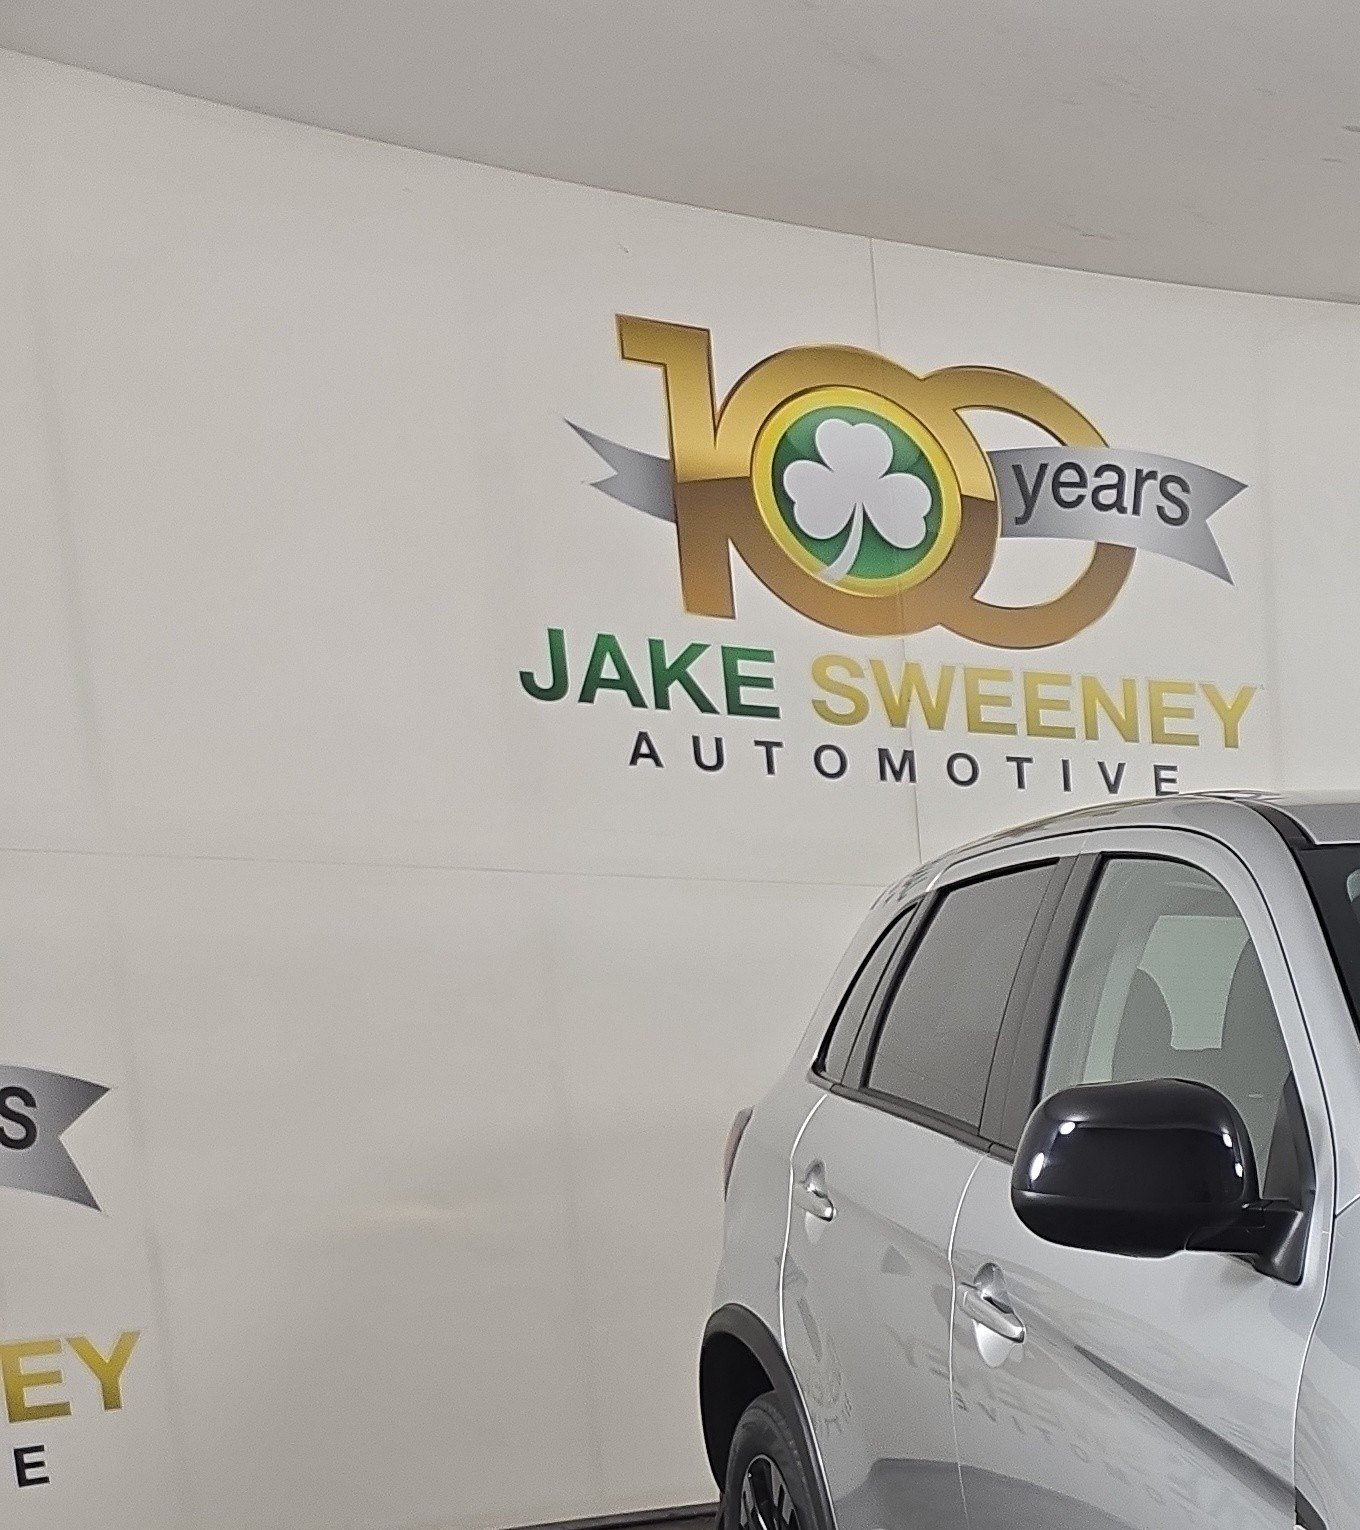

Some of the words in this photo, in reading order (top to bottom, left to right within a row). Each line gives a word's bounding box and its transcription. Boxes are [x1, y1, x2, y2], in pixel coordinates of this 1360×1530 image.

[616, 313, 1138, 650] 100
[1013, 460, 1193, 528] years
[518, 626, 781, 720] JAKE
[810, 653, 1259, 750] SWEENEY
[628, 730, 1181, 797] AUTOMOTIVE
